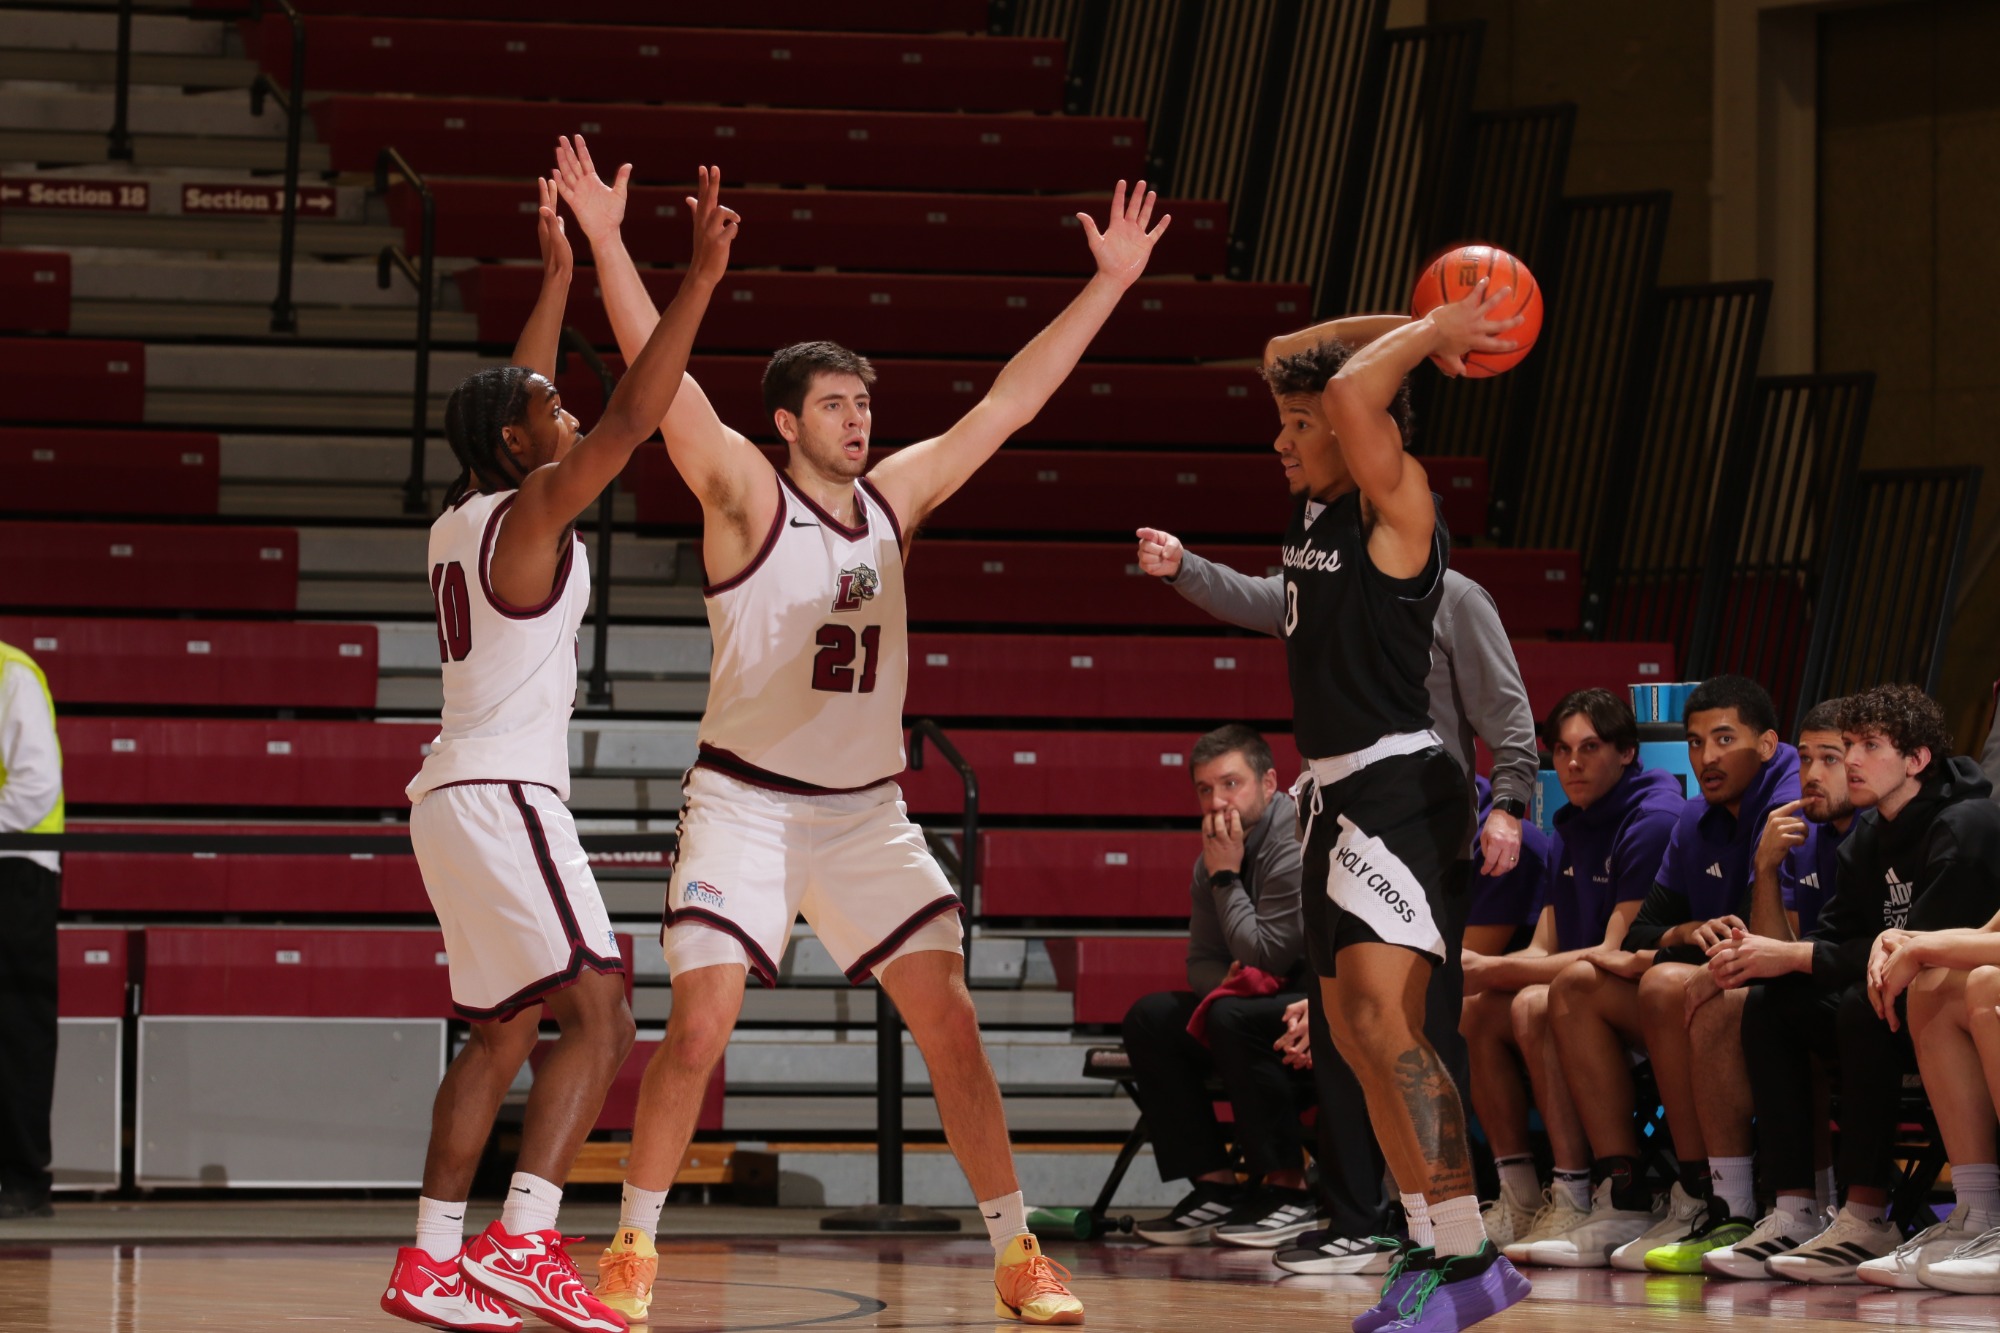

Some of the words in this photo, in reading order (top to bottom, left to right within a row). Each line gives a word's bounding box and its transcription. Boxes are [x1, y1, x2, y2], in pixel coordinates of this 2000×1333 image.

[28, 183, 113, 206] Section
[118, 186, 146, 206] 18
[186, 188, 269, 210] Section
[811, 623, 881, 694] 21
[1336, 847, 1373, 878] HOLY
[1367, 873, 1416, 923] CROSS
